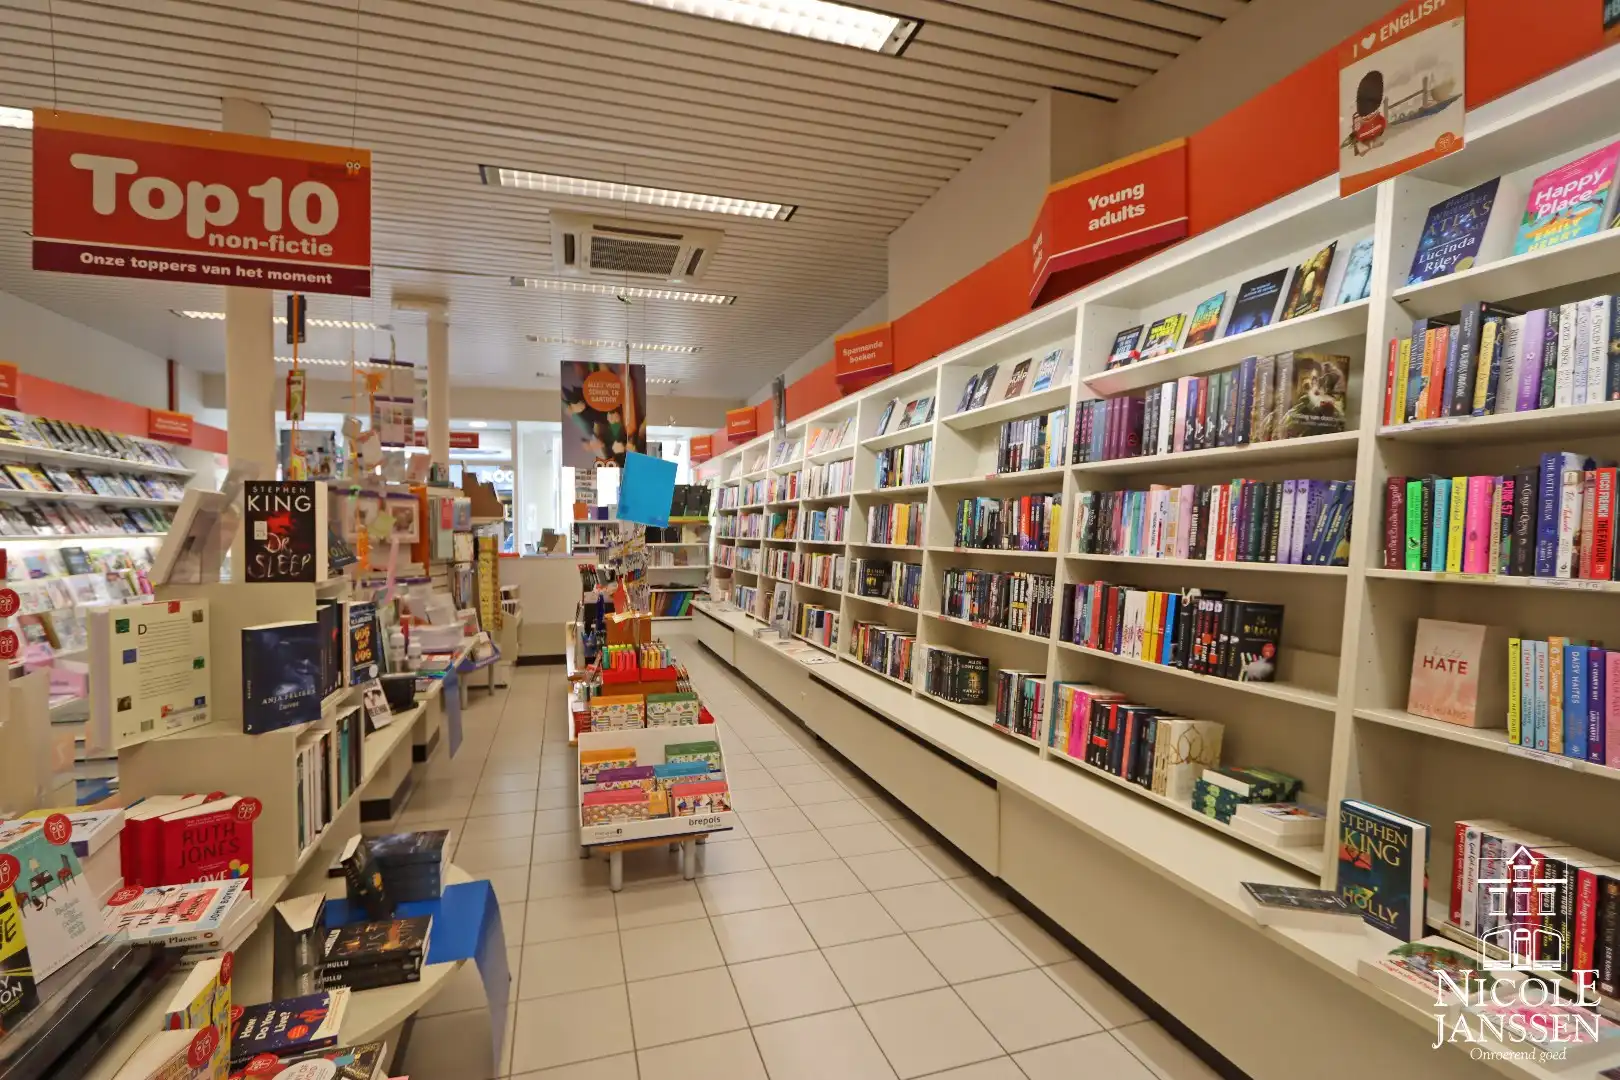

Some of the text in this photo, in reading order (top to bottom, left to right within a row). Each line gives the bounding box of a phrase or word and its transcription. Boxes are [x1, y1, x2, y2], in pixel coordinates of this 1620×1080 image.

[1352, 0, 1446, 58] I ENGLISH
[70, 153, 339, 239] Top 10
[1088, 183, 1145, 211] Young
[1535, 165, 1607, 206] Happy
[1088, 203, 1146, 231] adults
[1537, 190, 1593, 218] place
[208, 231, 333, 257] non-fictie
[1418, 236, 1475, 264] Lucinda
[80, 252, 332, 285] Onze toppers van het moment
[1425, 253, 1461, 272] Riley
[842, 341, 883, 356] Spannende
[849, 352, 876, 364] boeken
[247, 495, 312, 512] KING
[252, 486, 306, 494] STEPHEN
[1502, 480, 1515, 515] PUNK 57
[1544, 458, 1556, 521] THE BATTLE DRUM
[1595, 472, 1611, 563] NICCI FRENCH THE FAVOUR
[247, 553, 311, 578] SLEEP
[1423, 655, 1468, 676] HATE
[1571, 651, 1580, 704] DAISY HAITES
[262, 692, 281, 705] ANJA
[182, 822, 236, 845] RUTH
[688, 816, 721, 826] brepols
[1339, 811, 1408, 848] STEPHEN
[179, 838, 241, 870] JONES
[1344, 826, 1401, 867] KING
[209, 883, 241, 922] JOHN BOYNE
[1580, 878, 1592, 899] Daisy
[1343, 886, 1399, 925] HOLLY
[1580, 901, 1592, 922] Jones
[169, 935, 198, 945] Places
[239, 1018, 257, 1040] How
[255, 1009, 277, 1041] Do You
[274, 1011, 291, 1034] Live?
